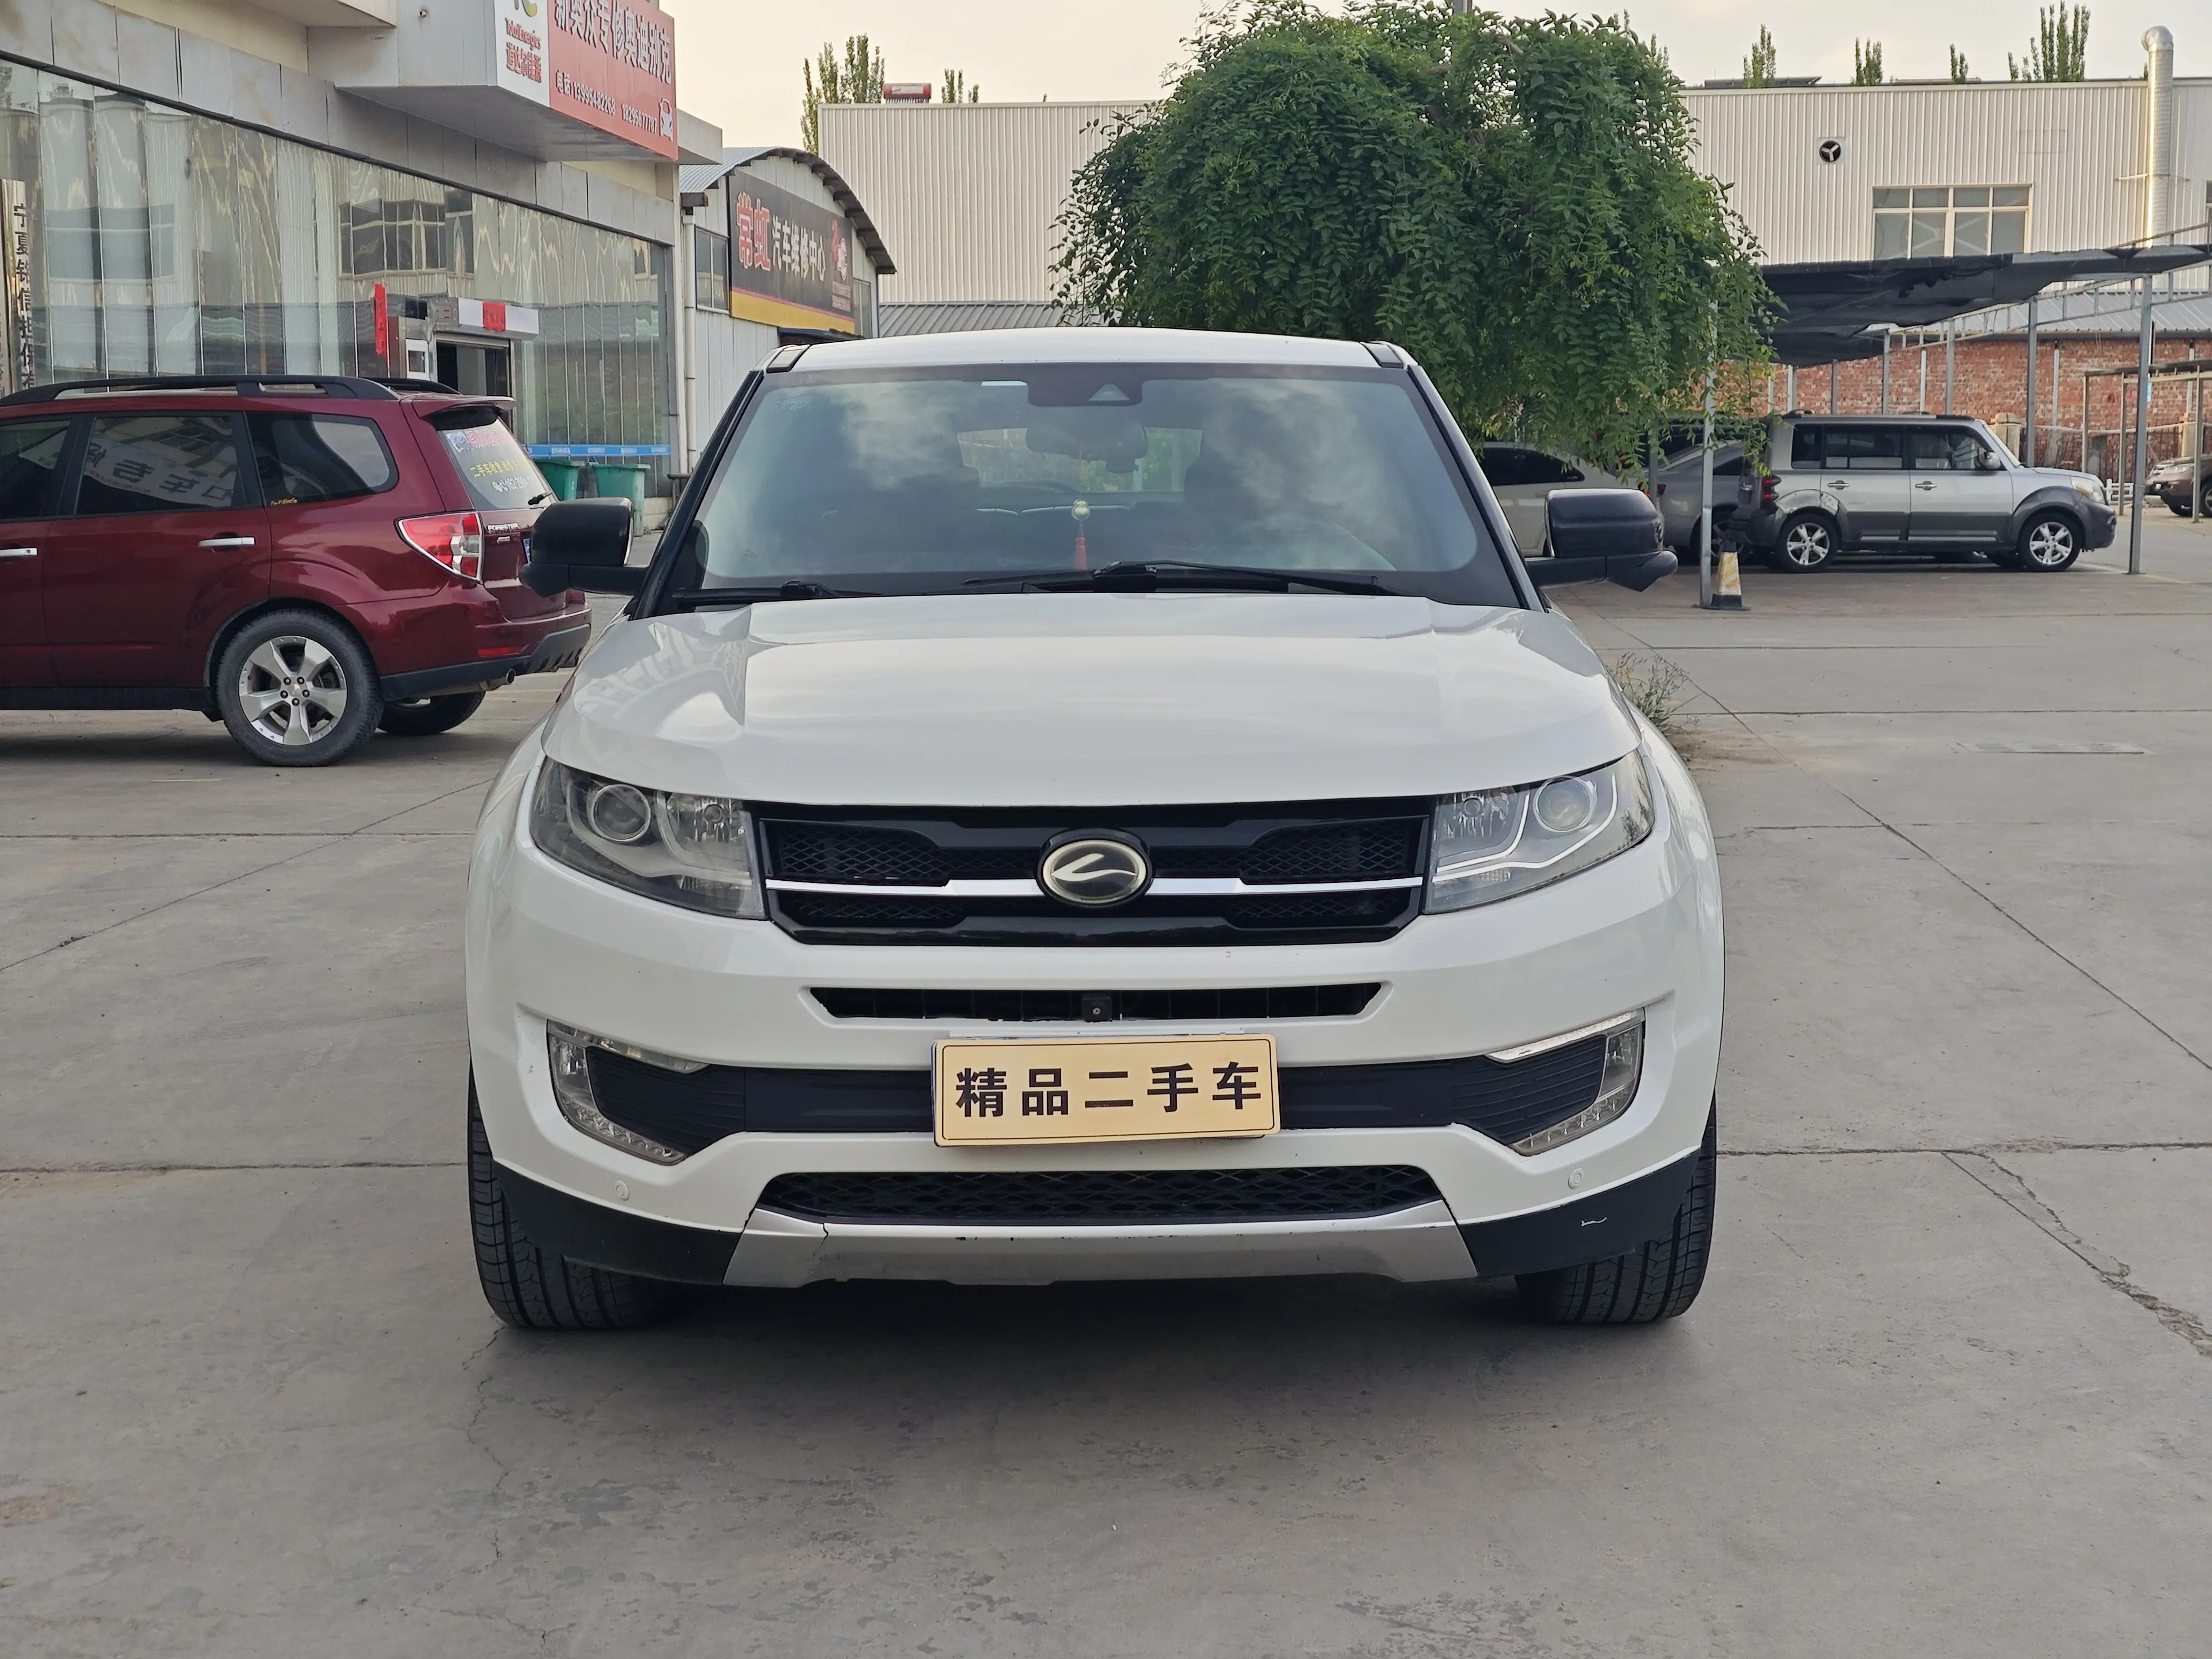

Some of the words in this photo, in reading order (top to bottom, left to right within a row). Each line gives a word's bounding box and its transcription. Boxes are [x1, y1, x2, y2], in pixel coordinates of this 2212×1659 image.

[772, 214, 826, 281] 汽车维修中心
[956, 1061, 1262, 1118] 精品二手车
